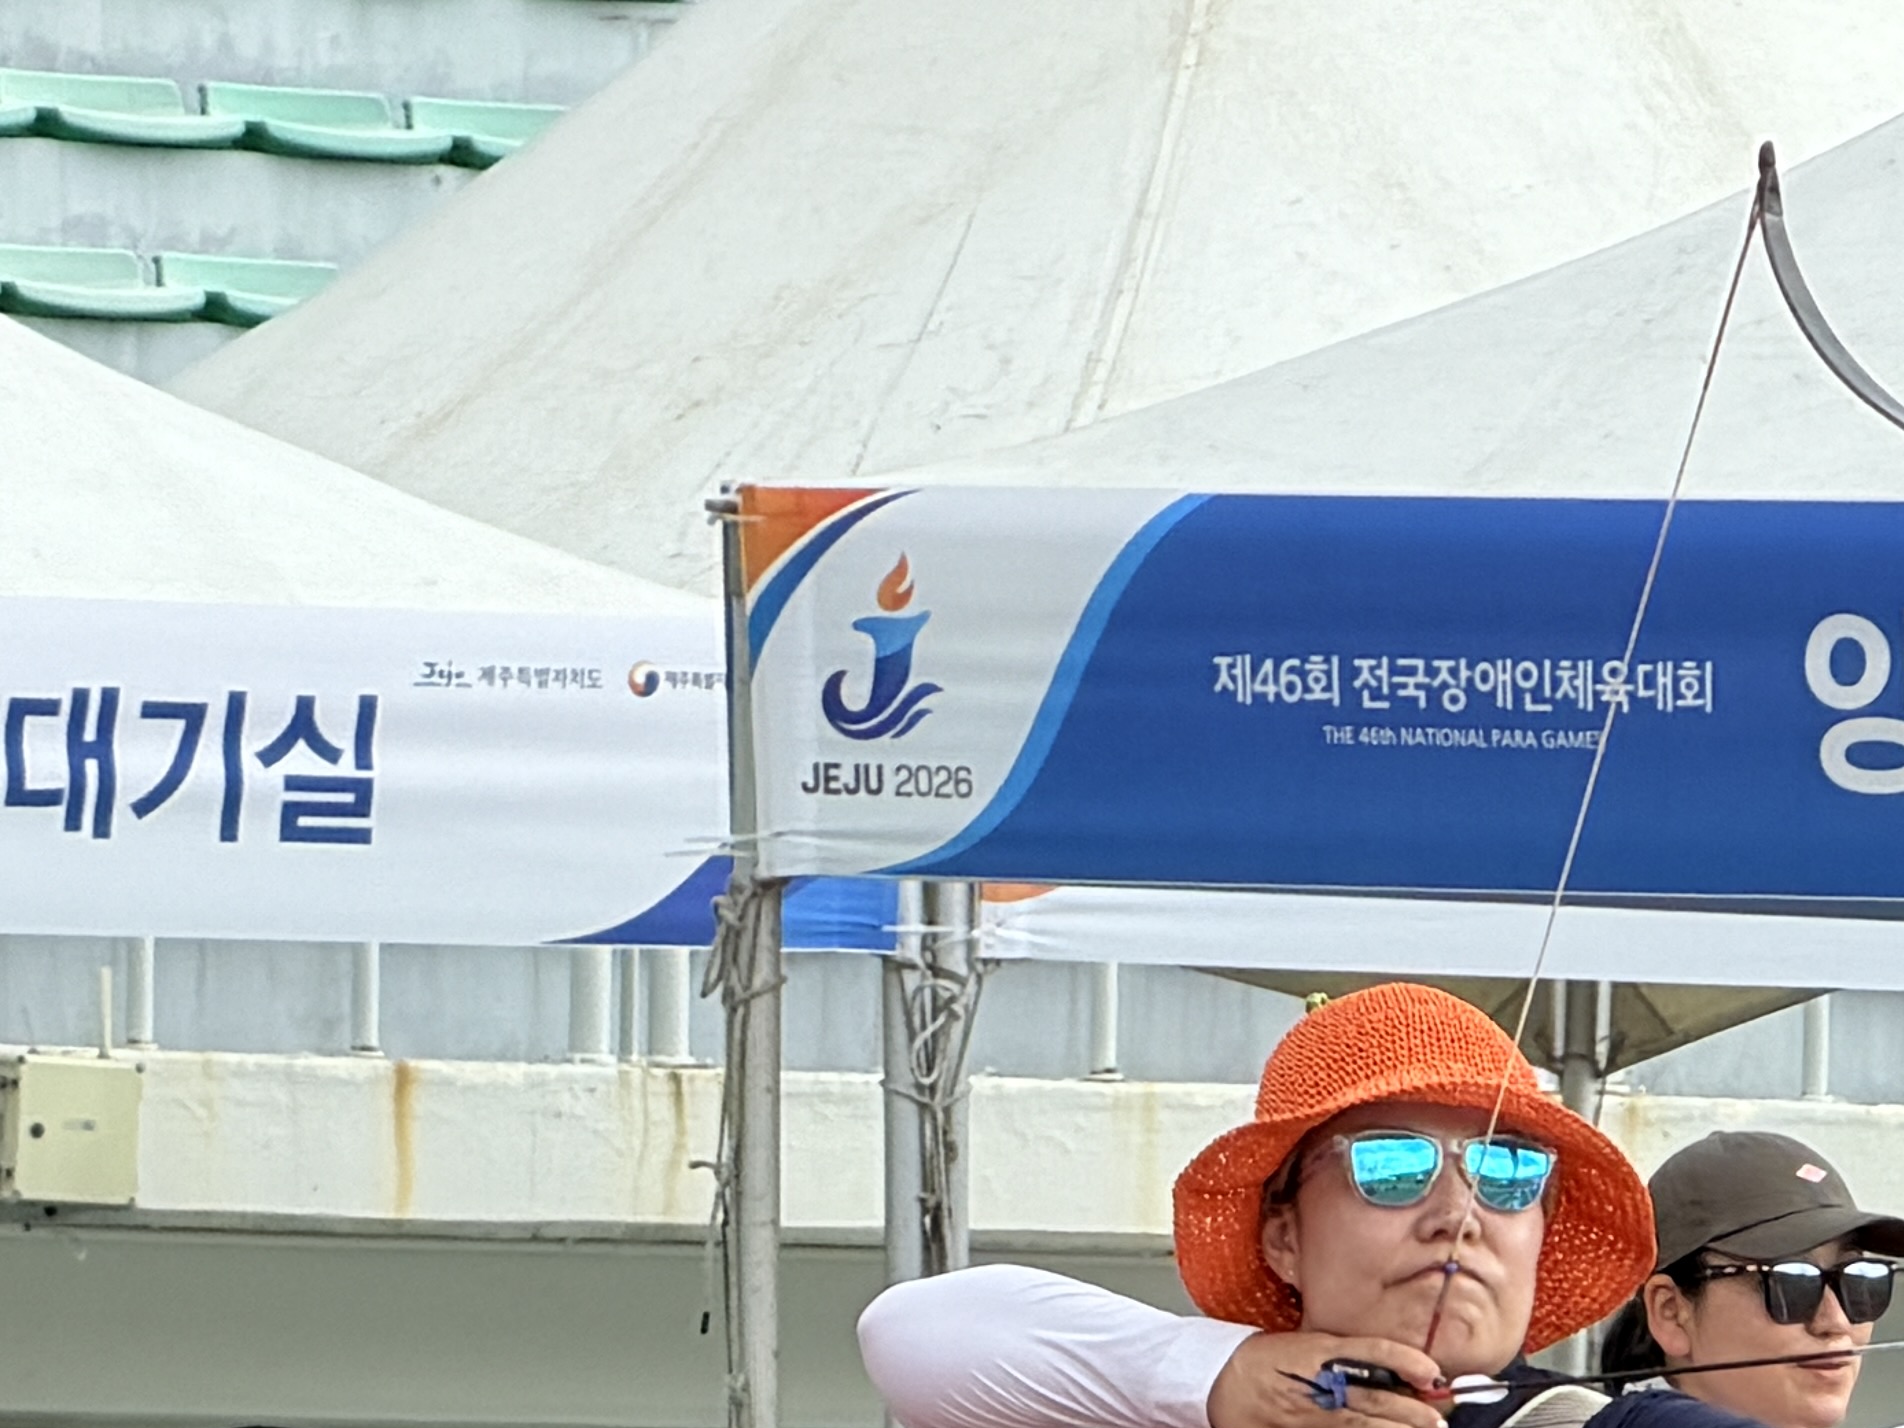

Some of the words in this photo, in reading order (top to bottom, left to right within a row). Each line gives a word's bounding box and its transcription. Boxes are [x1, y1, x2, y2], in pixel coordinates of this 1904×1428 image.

[477, 664, 603, 690] 제주특별자치도
[1212, 653, 1341, 707] 제46회
[1352, 656, 1714, 713] 전국장애인체육대회
[1322, 724, 1356, 745] THE
[1400, 725, 1489, 748] NATIONAL
[1491, 727, 1538, 750] PARA
[4, 685, 379, 846] 대기실
[801, 761, 883, 796] JEJU
[894, 763, 973, 800] 2026
